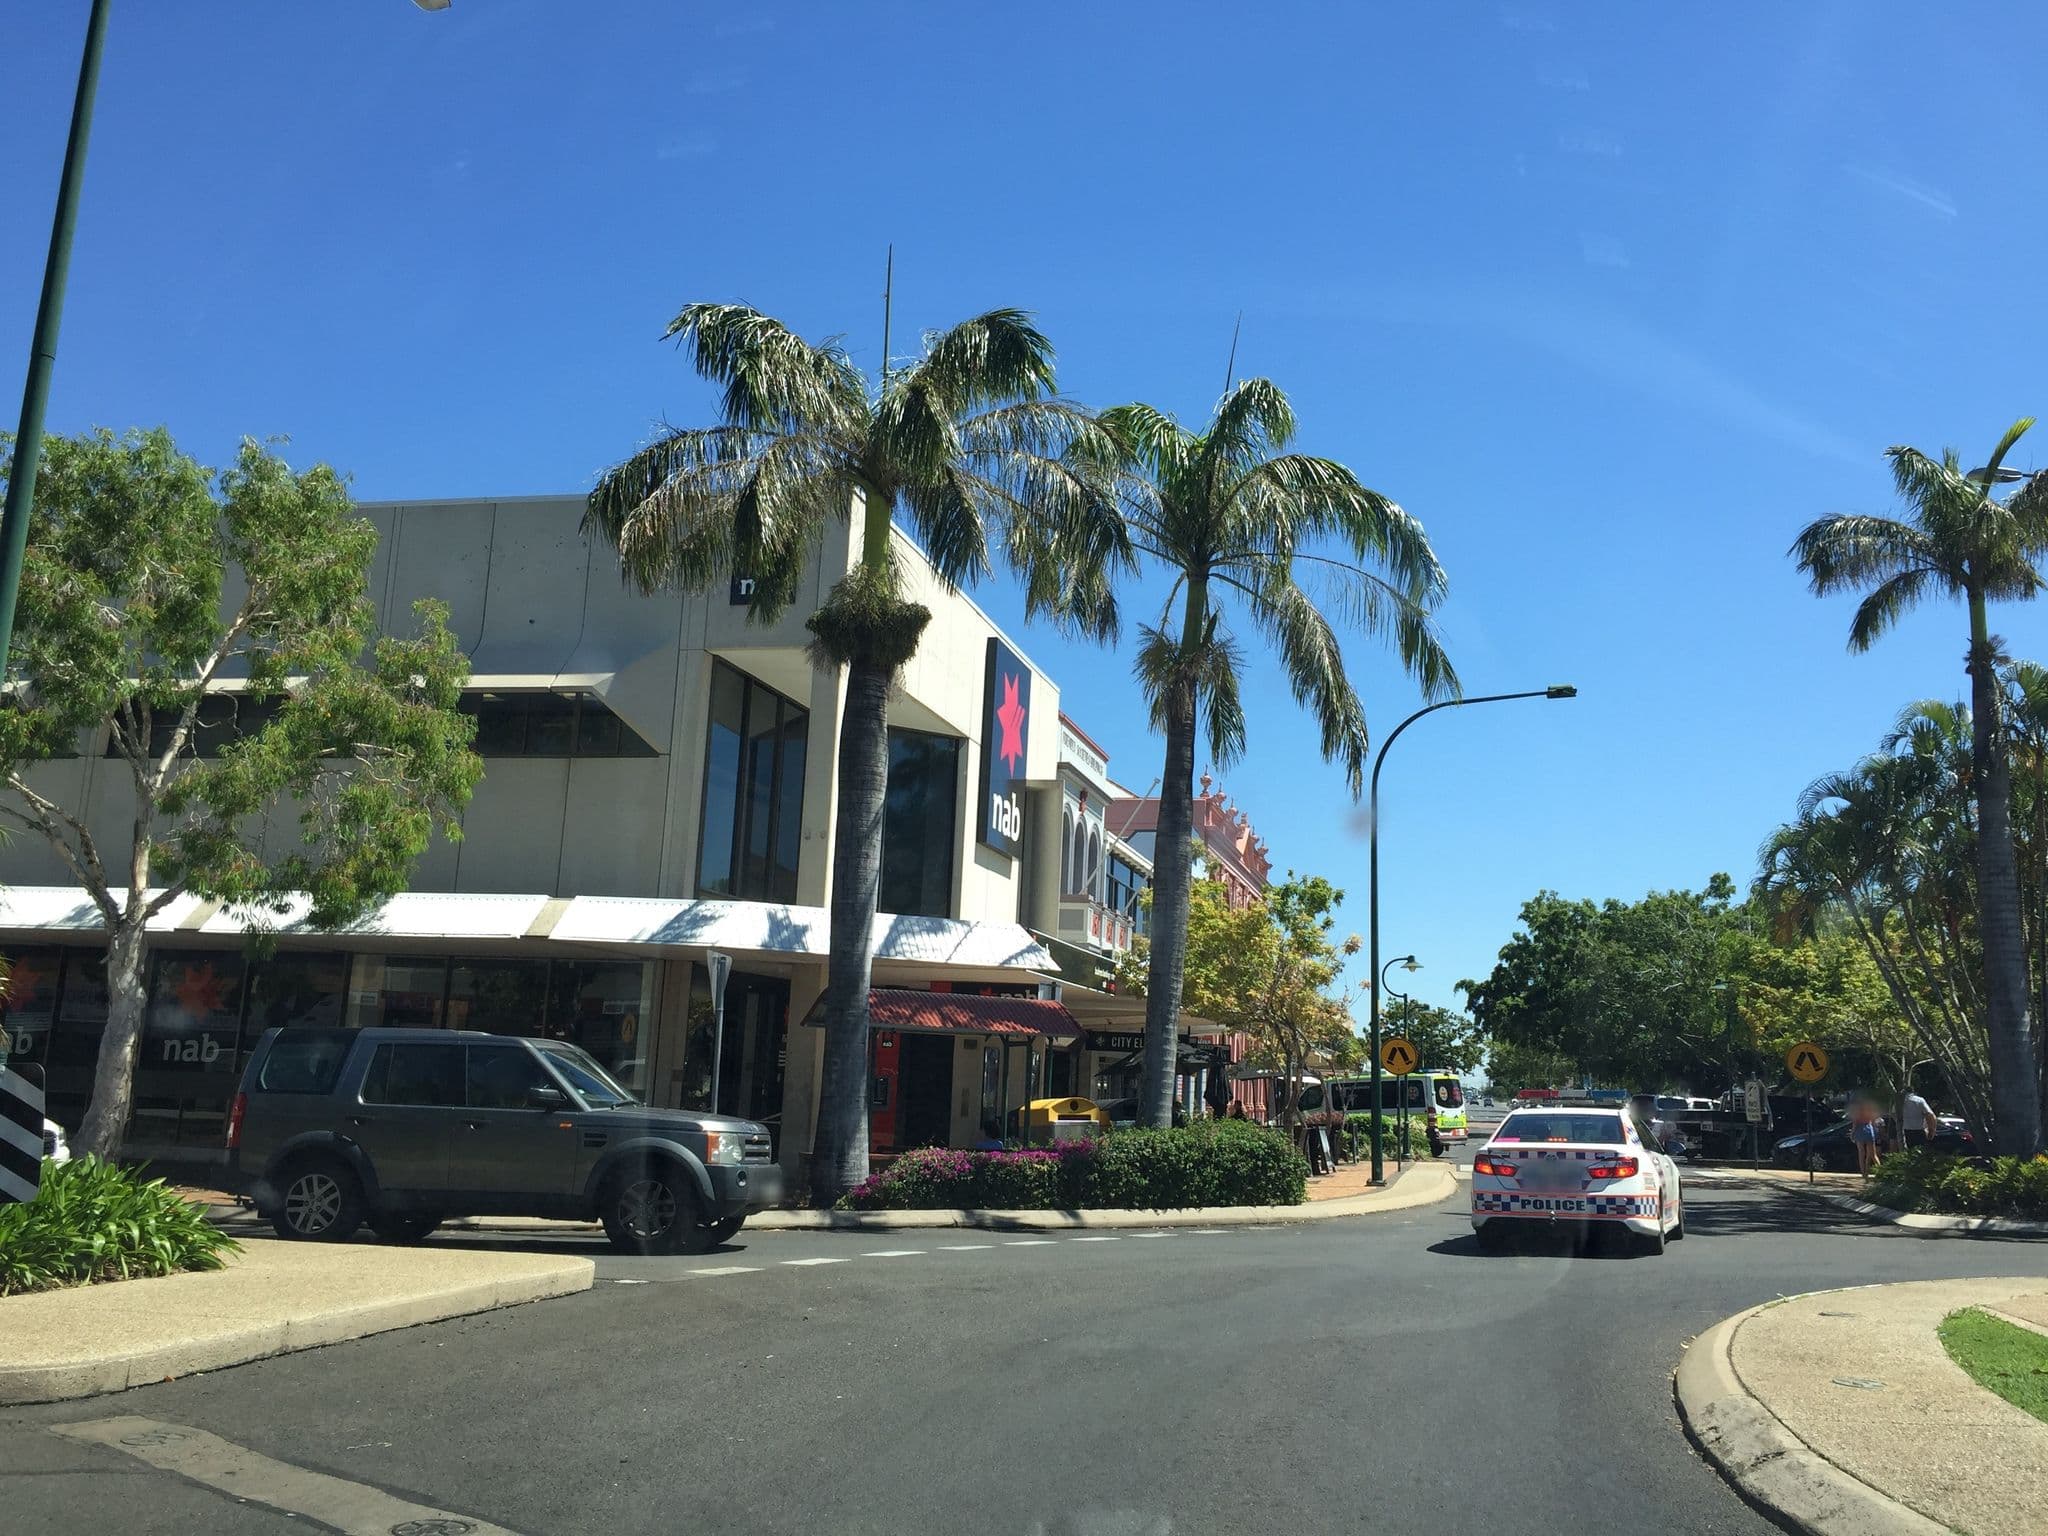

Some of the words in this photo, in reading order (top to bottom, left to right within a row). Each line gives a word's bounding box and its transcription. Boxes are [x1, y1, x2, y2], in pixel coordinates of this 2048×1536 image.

[992, 791, 1021, 842] nab
[164, 1032, 219, 1062] nab
[1111, 1036, 1131, 1048] CITY
[1520, 1199, 1585, 1212] POLICE
